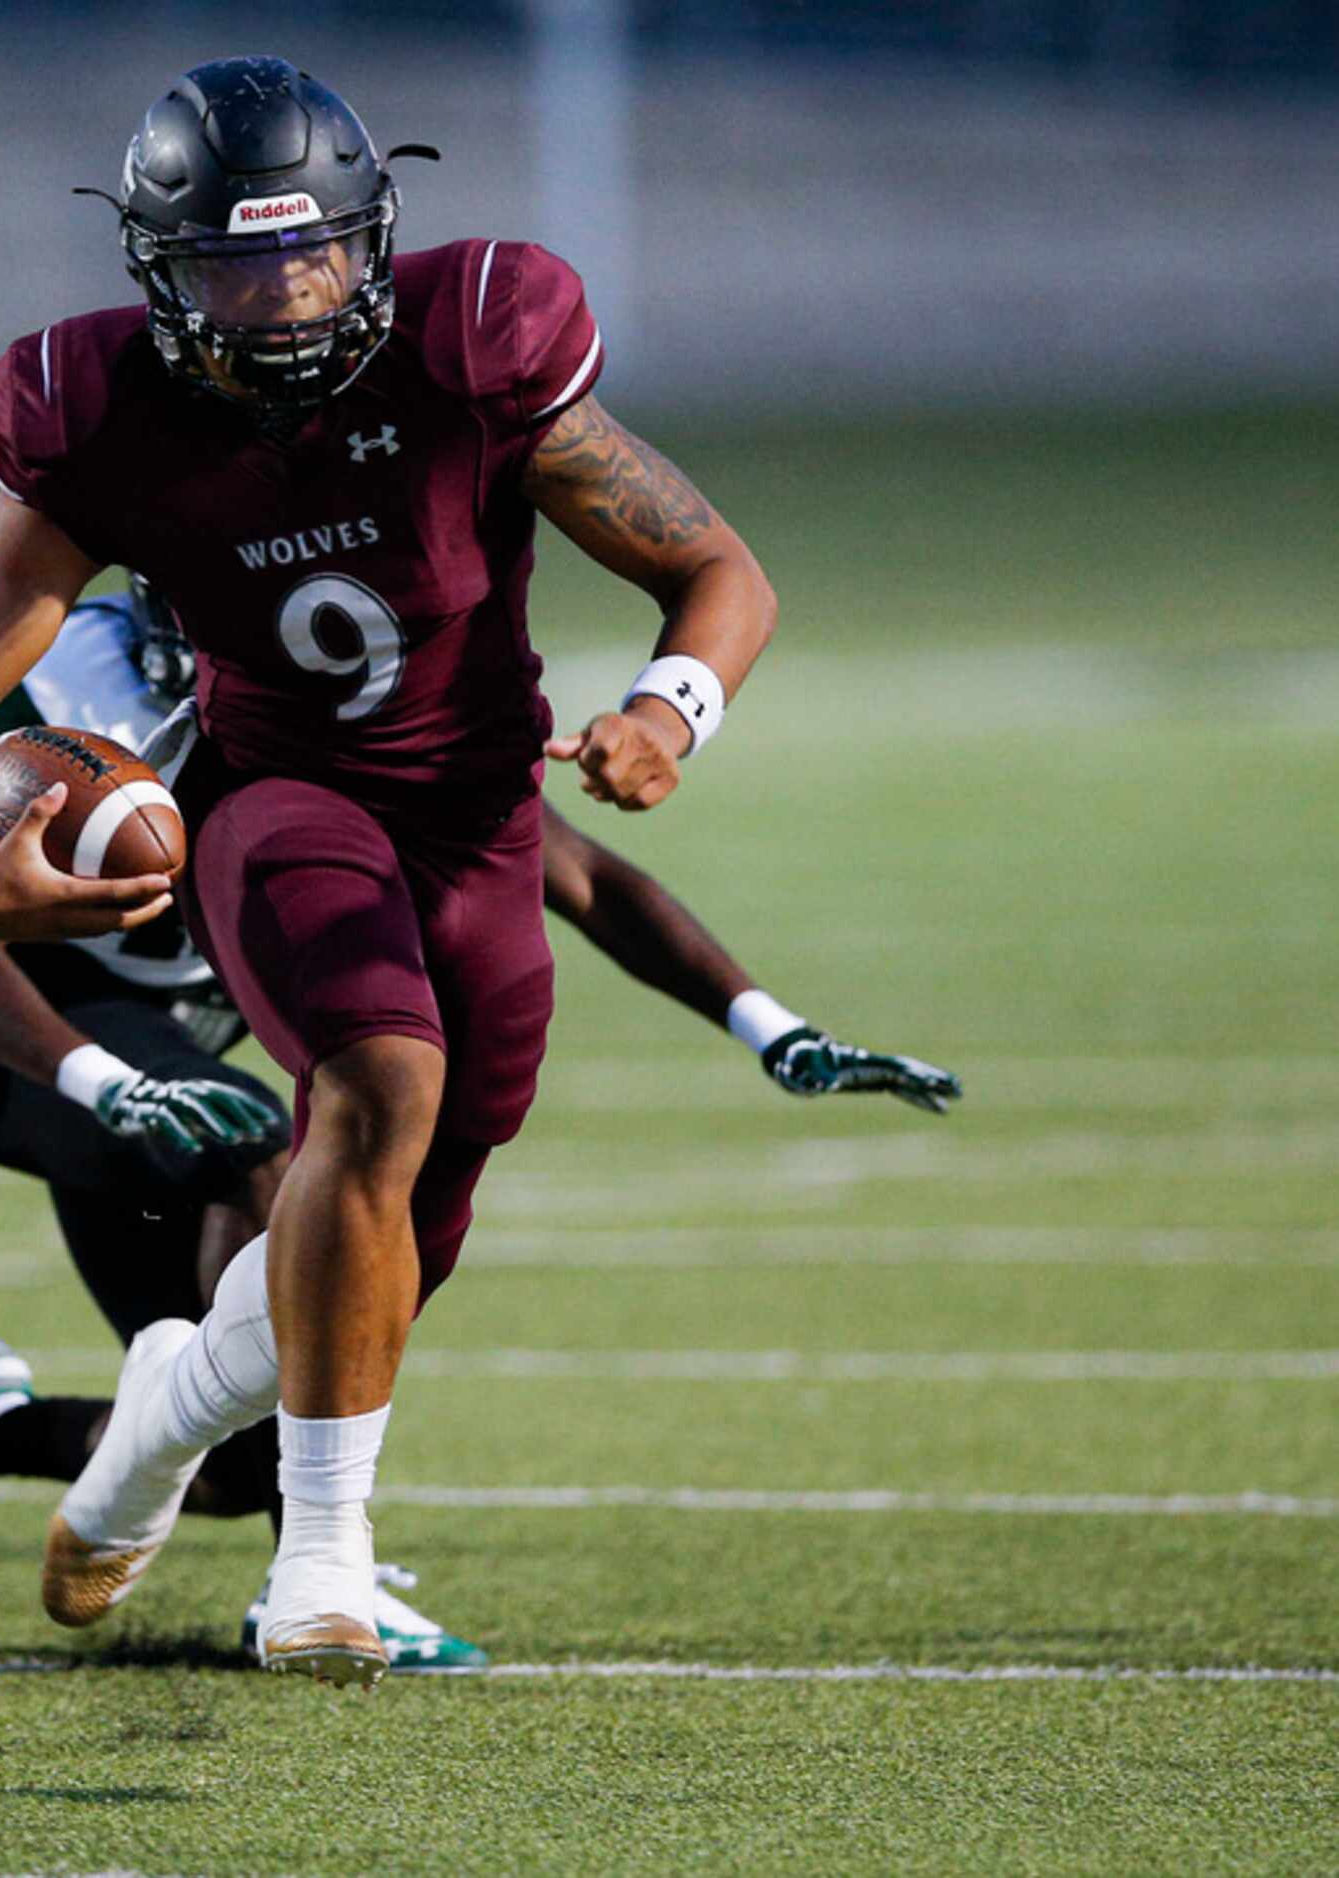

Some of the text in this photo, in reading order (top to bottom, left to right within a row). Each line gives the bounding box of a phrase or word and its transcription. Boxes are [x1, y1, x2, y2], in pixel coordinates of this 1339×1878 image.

[239, 198, 310, 221] Riddell
[237, 517, 380, 571] WOLVES
[276, 572, 408, 721] 9
